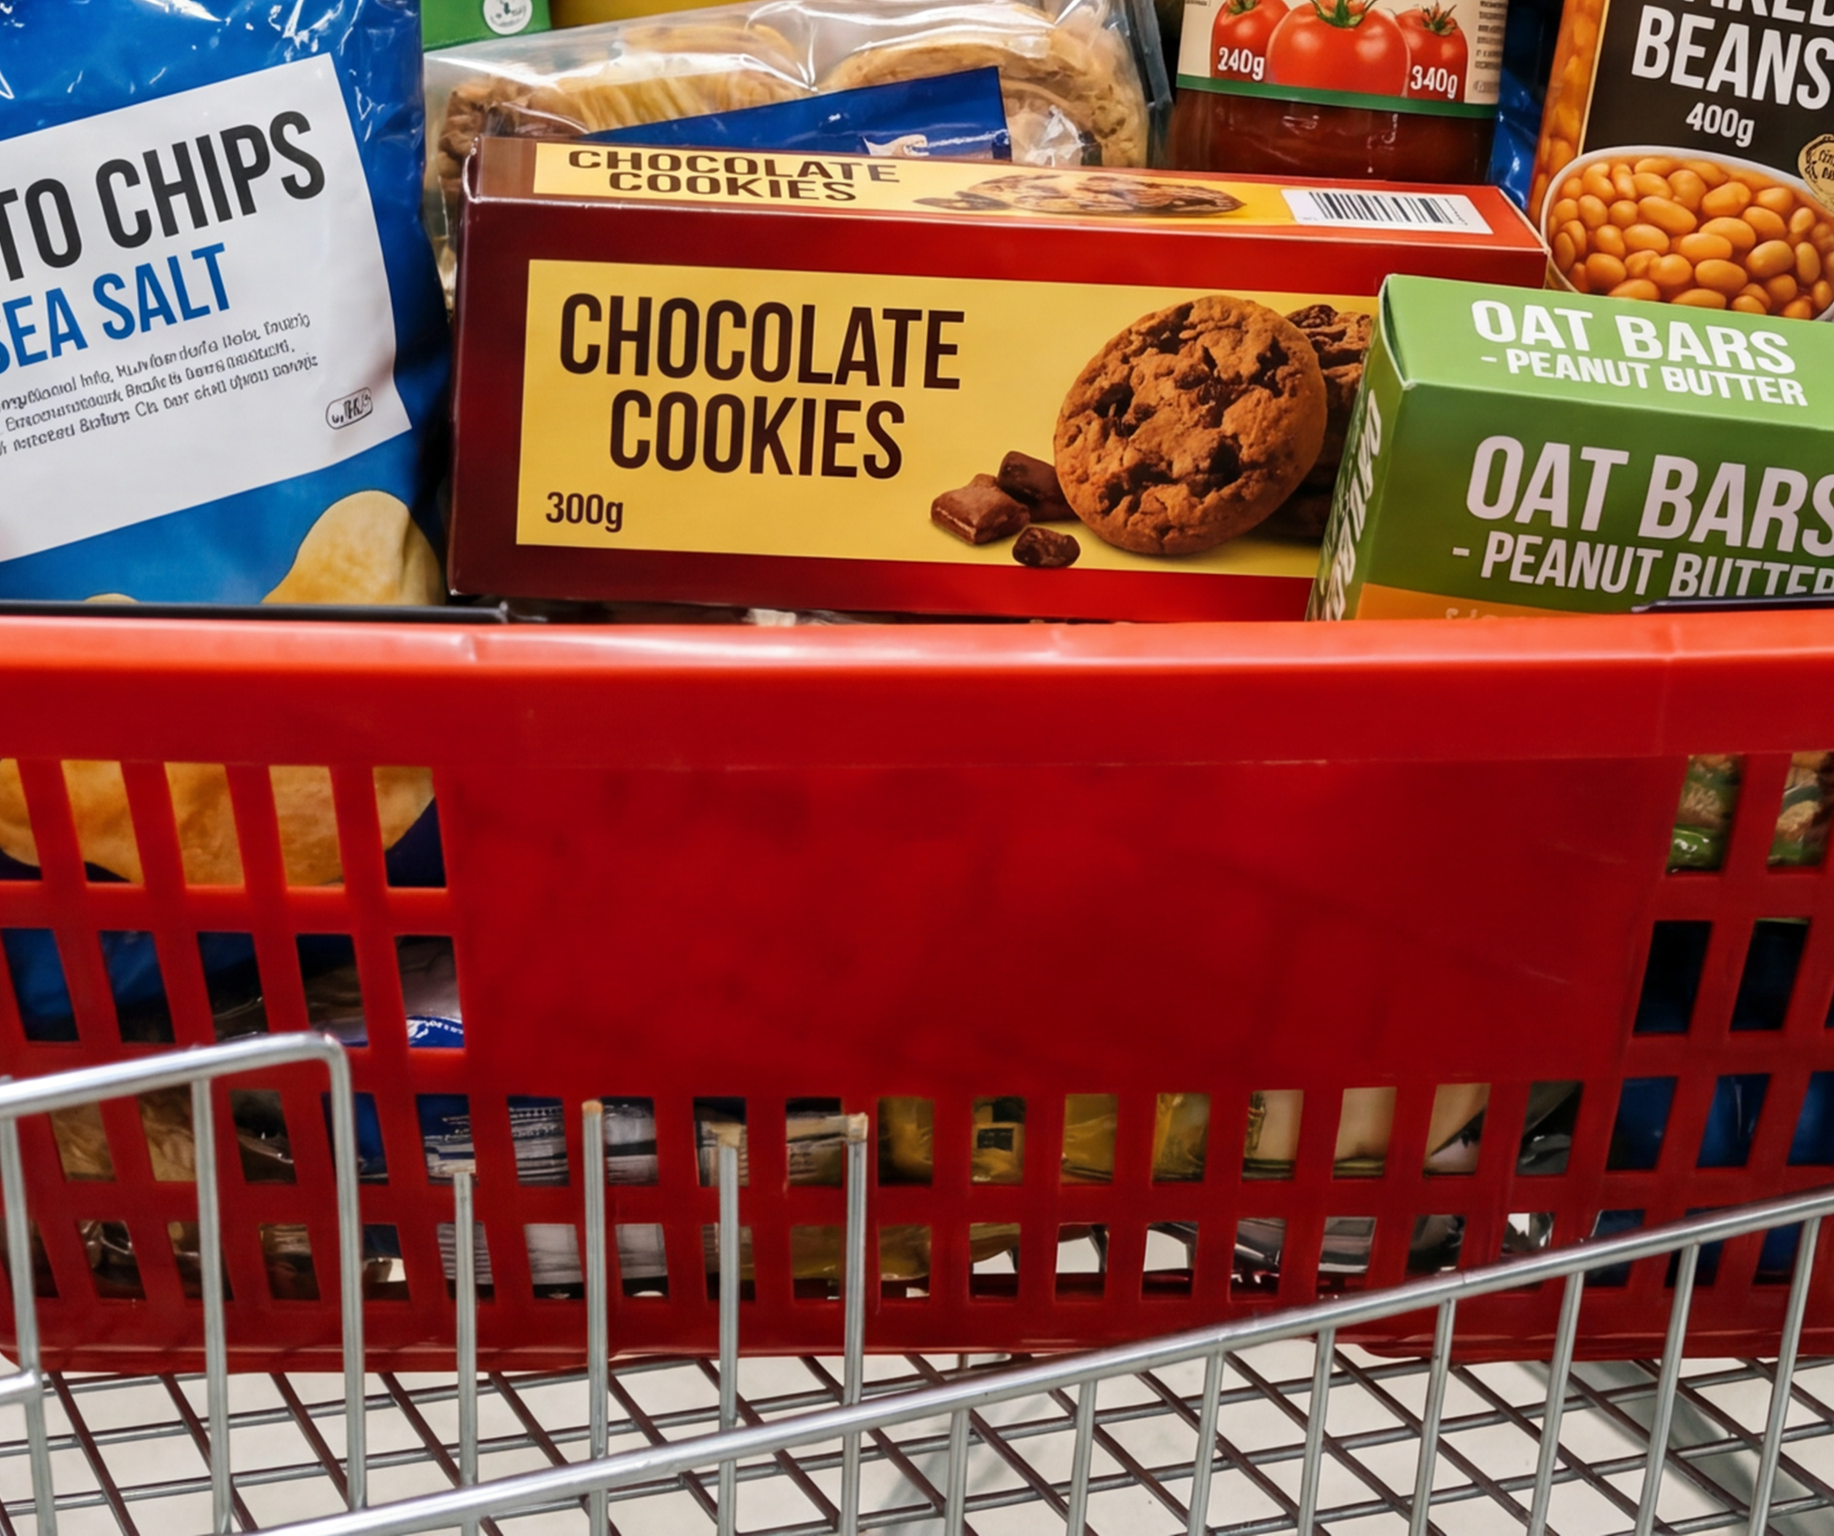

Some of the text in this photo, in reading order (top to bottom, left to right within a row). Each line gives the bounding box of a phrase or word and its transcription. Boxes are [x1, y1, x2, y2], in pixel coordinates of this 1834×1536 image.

[1218, 47, 1264, 80] 240g
[1411, 66, 1457, 99] 340g
[1686, 103, 1754, 147] 400g
[96, 111, 324, 248] CHIPS
[569, 151, 899, 182] CHOCOLATE
[610, 172, 856, 201] COOKIES
[93, 243, 229, 339] SALT
[561, 294, 964, 389] CHOCOLATE
[1471, 299, 1795, 374] OAT BARS
[1506, 349, 1648, 388] PEANUT
[1661, 366, 1807, 406] BUTTER
[611, 390, 904, 479] COOKIES
[546, 492, 623, 532] 300g
[1467, 436, 1629, 531] OAT
[1481, 531, 1663, 595] PEANUT
